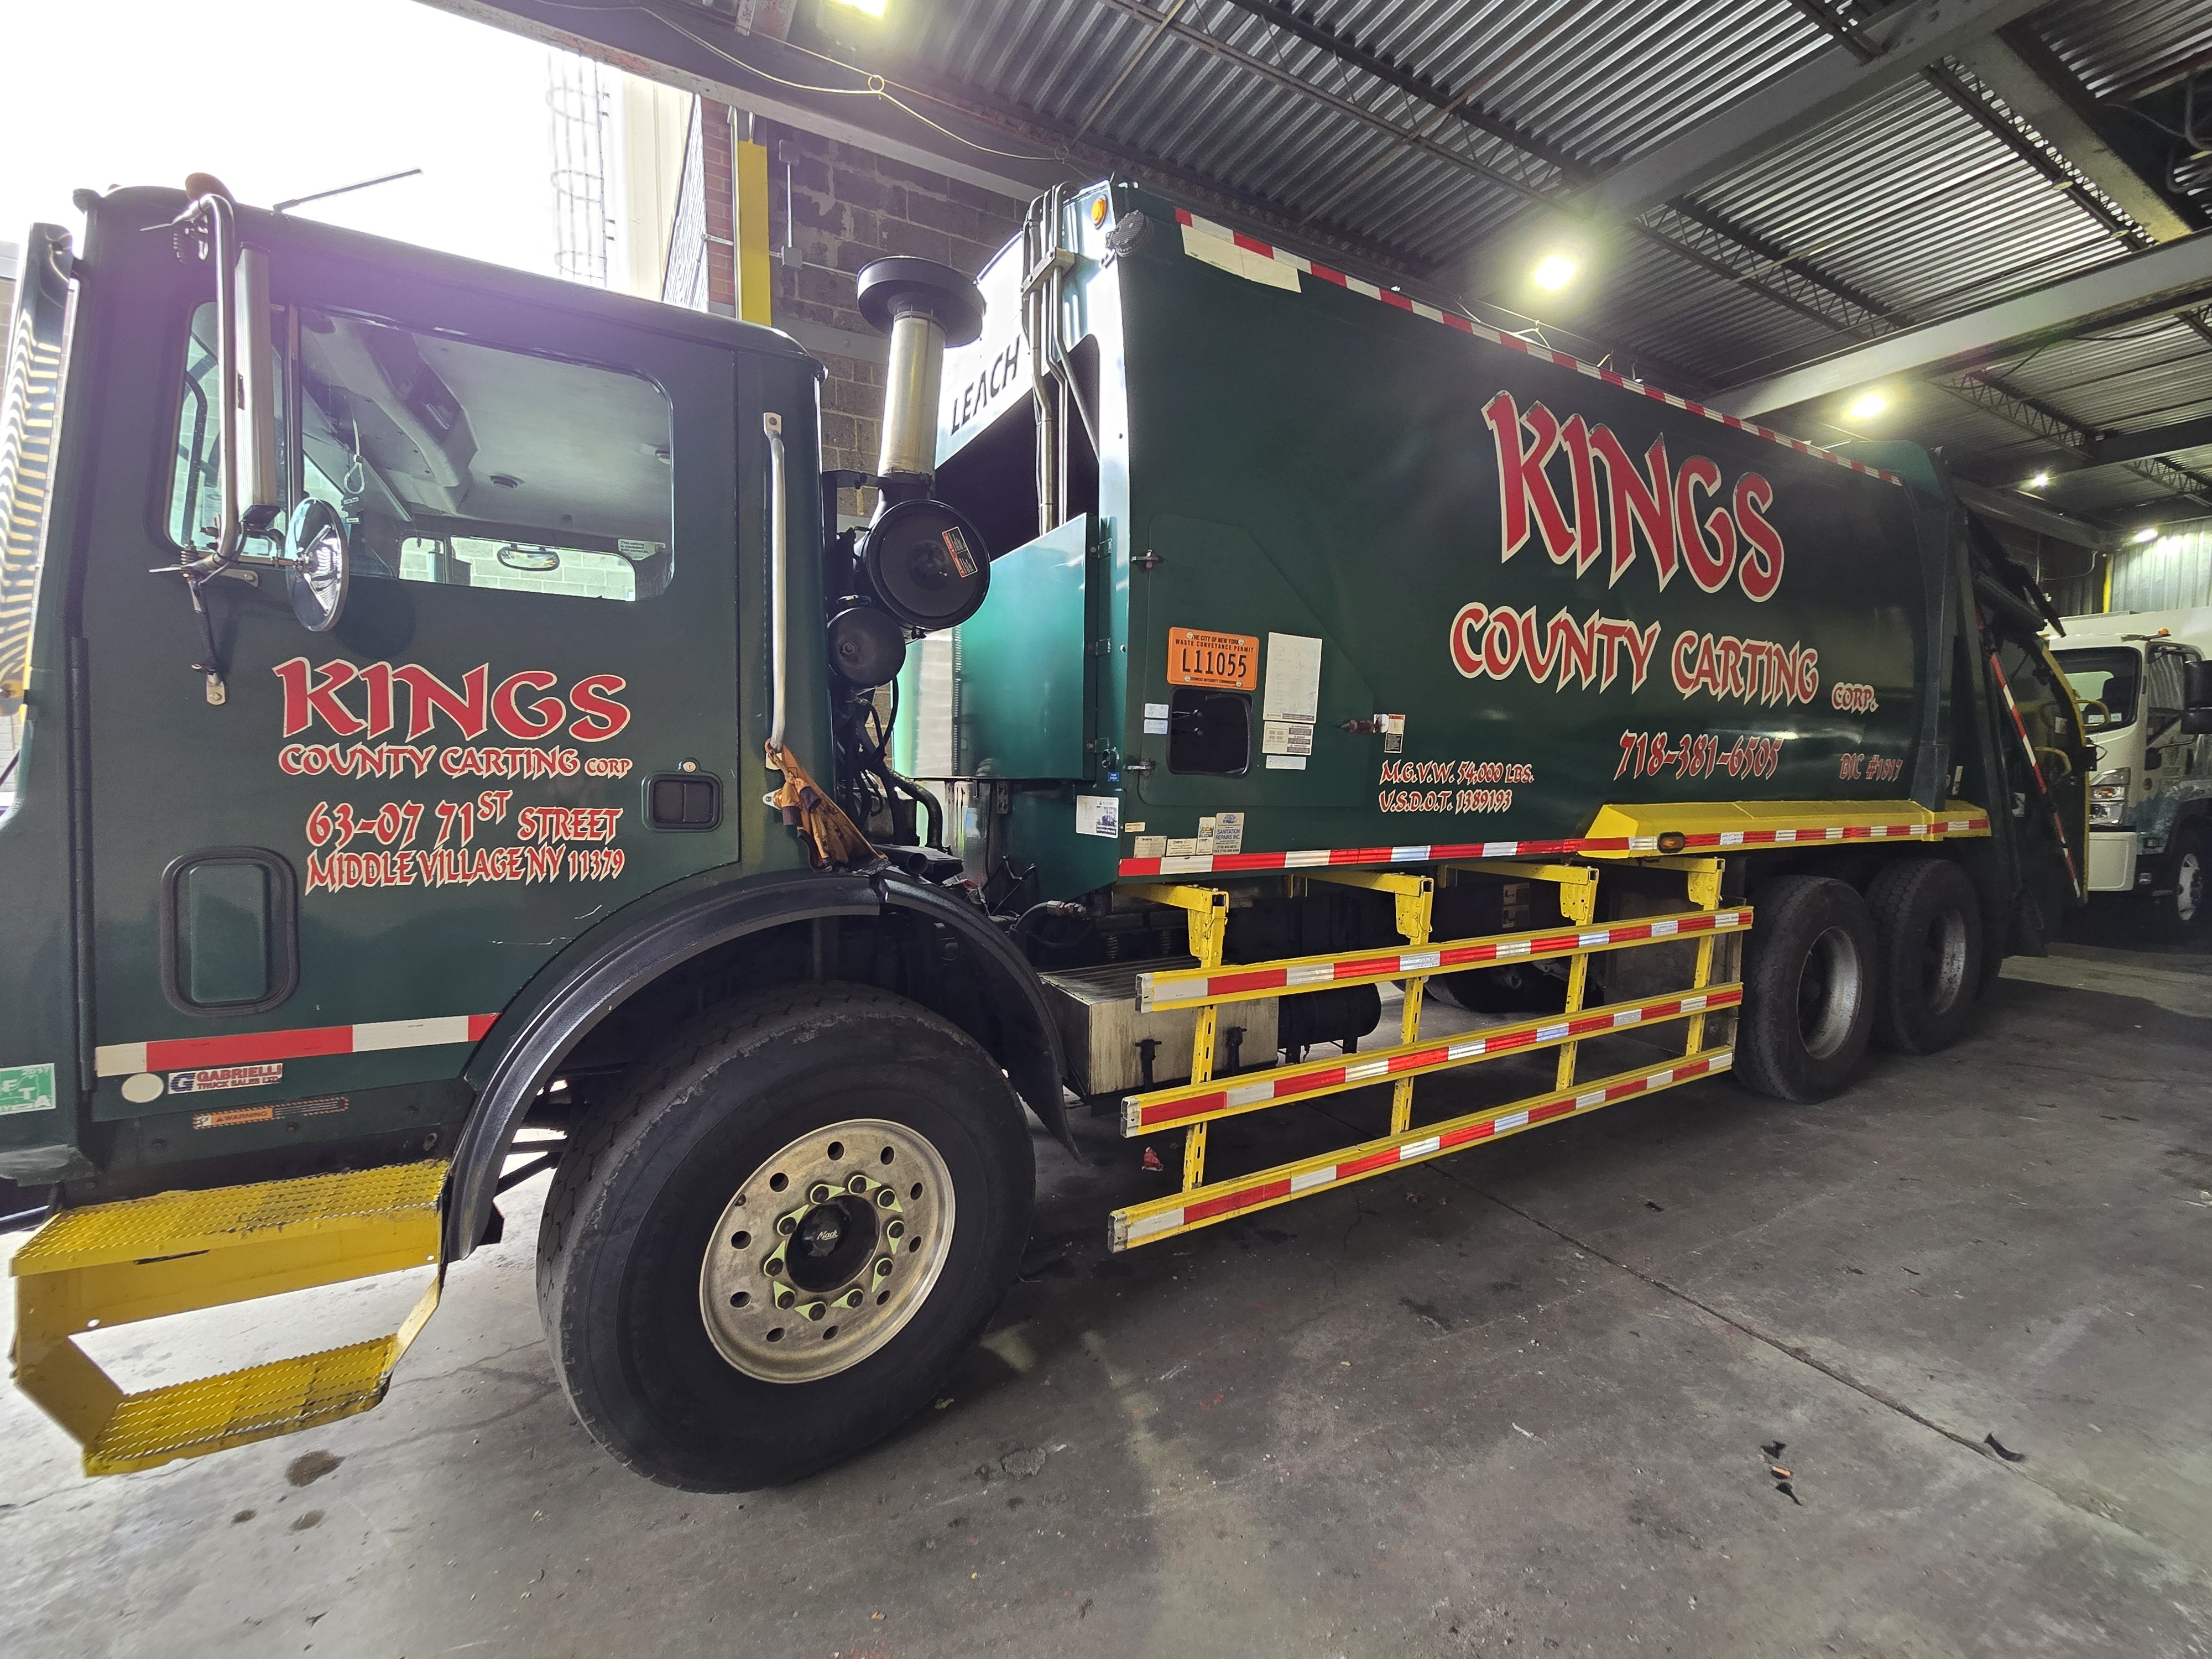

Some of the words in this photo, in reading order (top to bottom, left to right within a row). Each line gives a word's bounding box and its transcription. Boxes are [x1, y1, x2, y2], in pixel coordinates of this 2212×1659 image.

[950, 333, 1021, 437] LEACH
[1480, 390, 1785, 603] KINGS
[1197, 642, 1232, 650] CONVEYANCE
[1449, 602, 1661, 695] COUNTY
[1671, 630, 1819, 708] CARTING
[1832, 681, 1880, 714] CORP.
[1182, 648, 1246, 678] L11055
[272, 656, 630, 743] KINGS
[278, 742, 437, 779] COUNTY
[441, 744, 580, 780] CARTING
[585, 758, 633, 779] CORP
[1613, 728, 1785, 781] 718-381-6505
[1839, 753, 1865, 781] BIC
[1379, 759, 1455, 785] M.G.V.W.
[1504, 763, 1535, 784] LBS.
[1455, 789, 1512, 815] 1389193
[305, 800, 424, 849] 63-07
[517, 807, 623, 844] STREET
[305, 848, 416, 896] MIDDLE
[417, 846, 523, 888] VILLAGE
[524, 842, 567, 886] NY
[567, 848, 626, 881] 11379
[196, 1064, 281, 1082] GABRIELLI
[196, 1081, 229, 1090] TRUCK
[231, 1077, 260, 1086] SALES
[224, 1109, 268, 1121] WARNING
[816, 1229, 838, 1240] Mack
